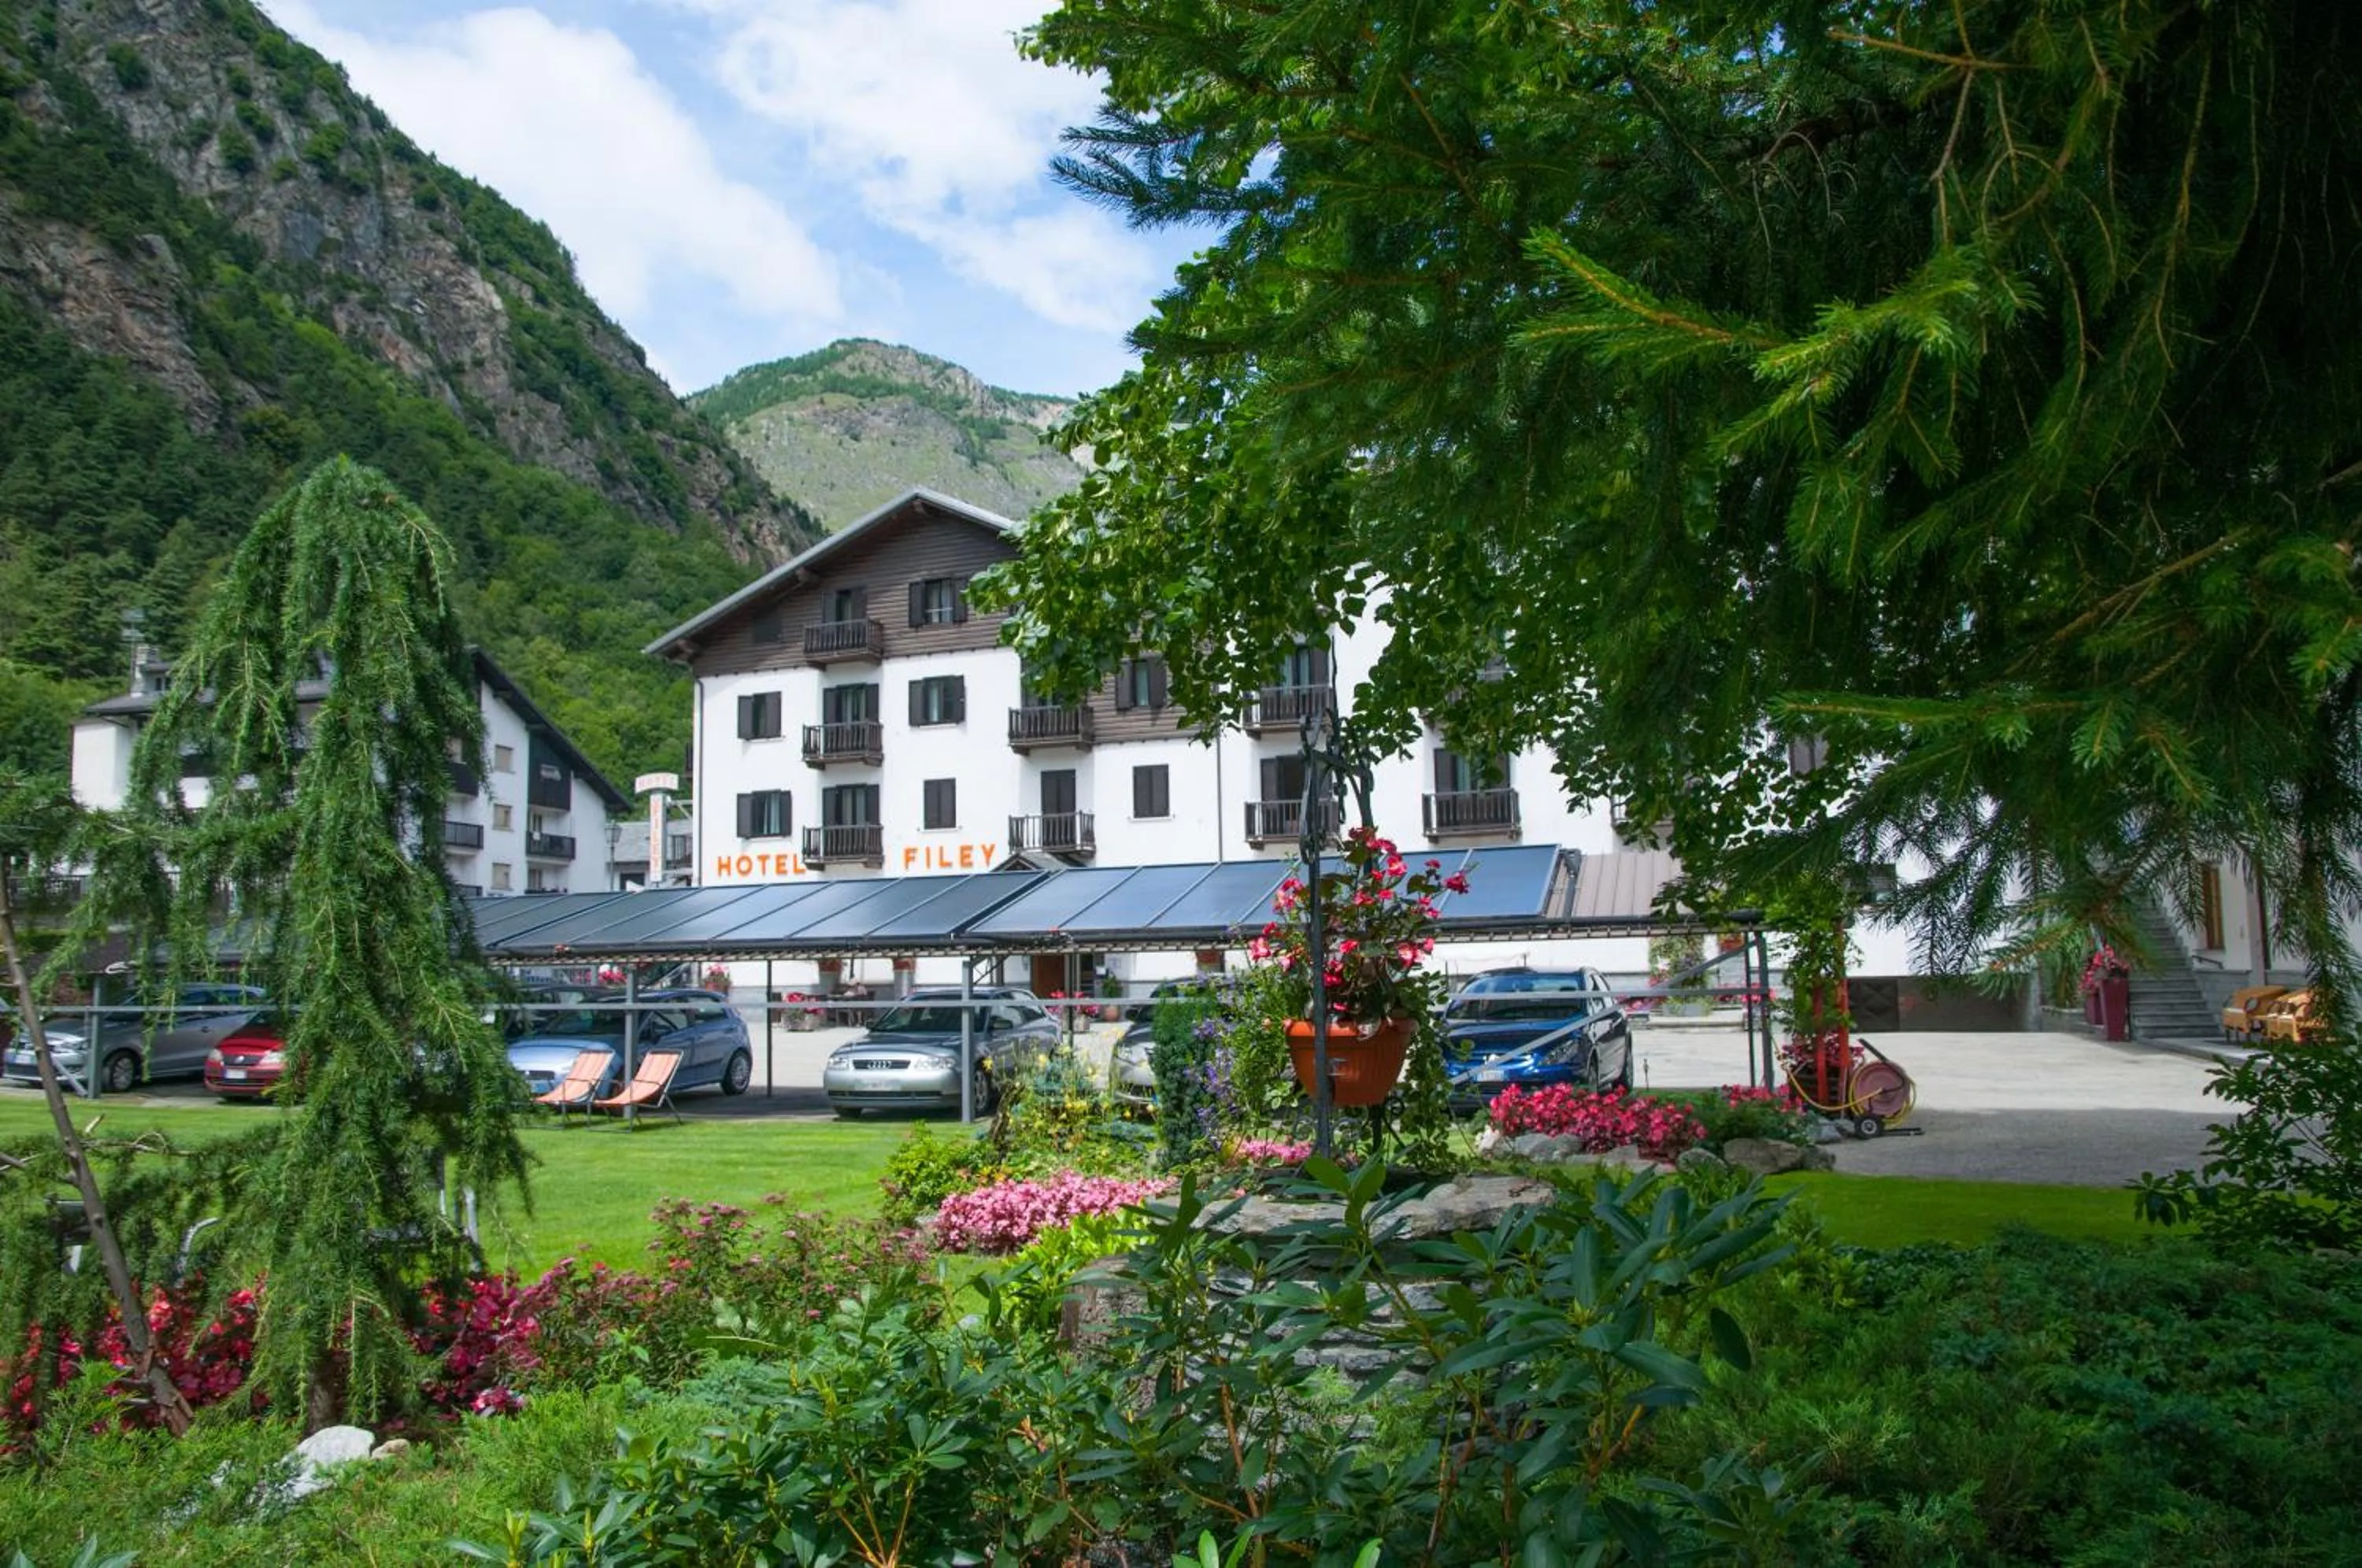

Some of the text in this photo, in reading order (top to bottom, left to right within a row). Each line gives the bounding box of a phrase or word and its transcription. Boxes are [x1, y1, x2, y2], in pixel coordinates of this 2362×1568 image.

[637, 775, 676, 789] HOTEL
[717, 844, 996, 877] HOTEL FILEY
